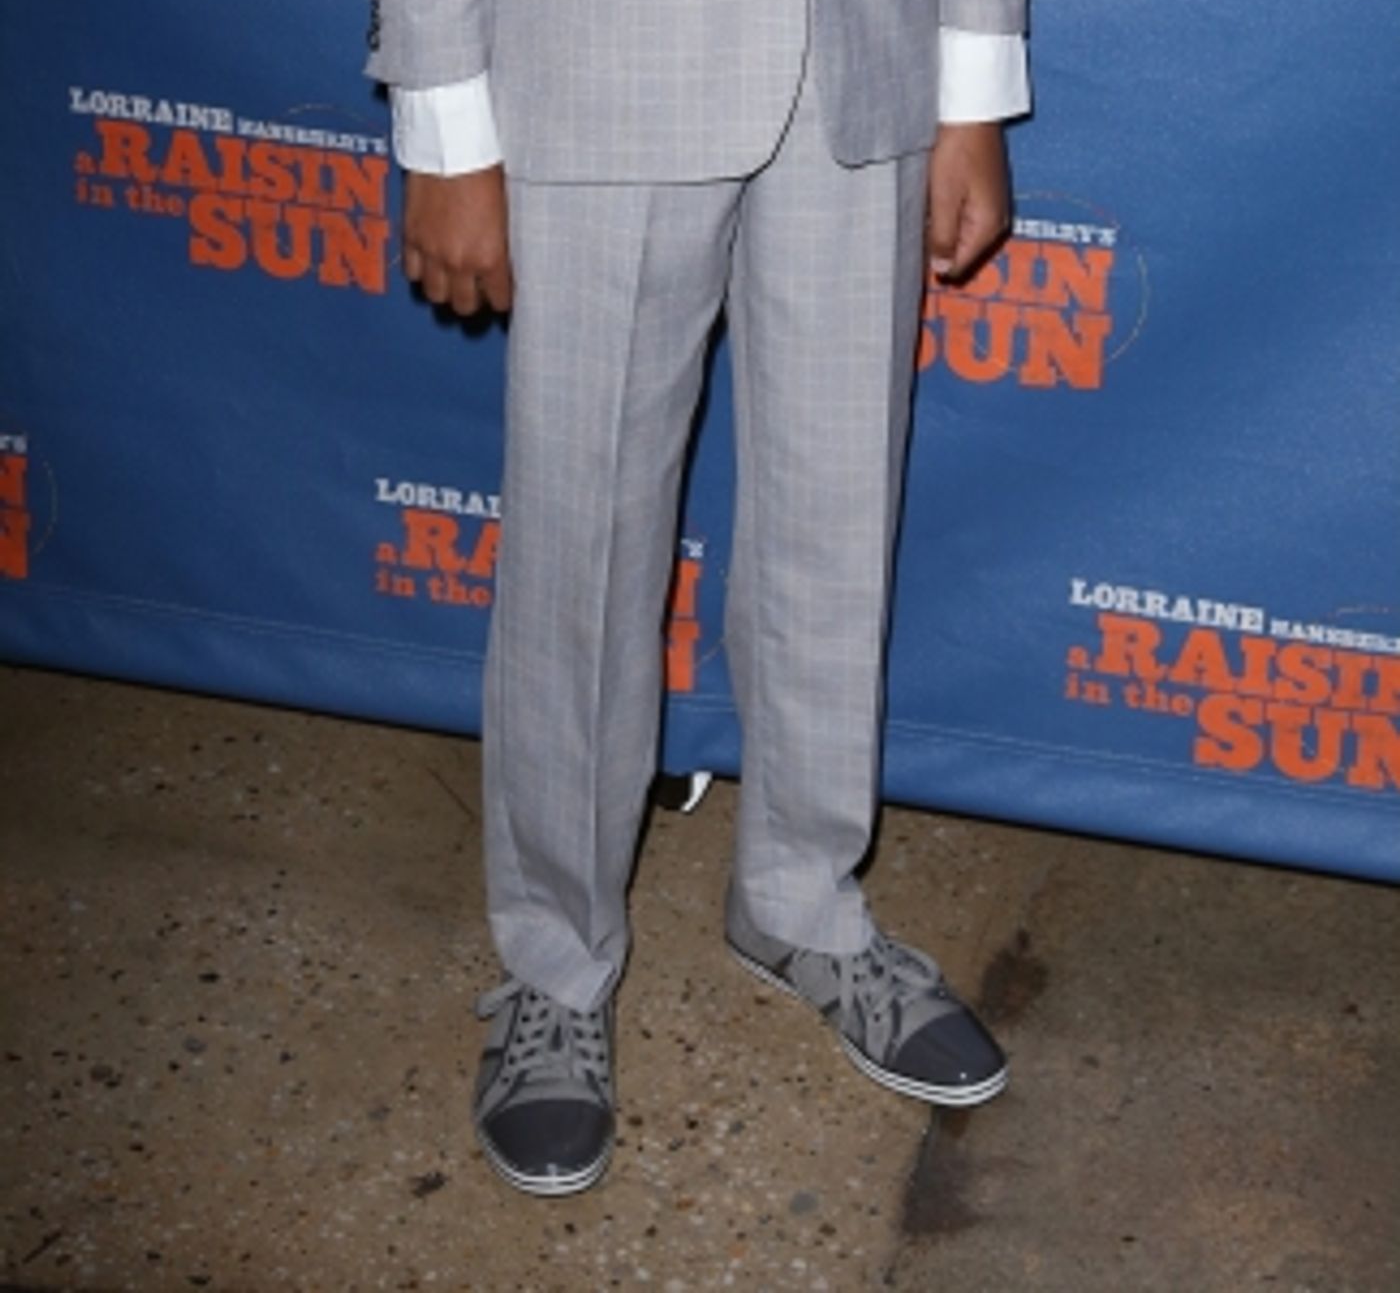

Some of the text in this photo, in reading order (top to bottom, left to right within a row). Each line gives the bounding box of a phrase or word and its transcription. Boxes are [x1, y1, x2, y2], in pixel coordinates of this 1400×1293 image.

[69, 87, 233, 132] LORRAINE
[74, 118, 389, 216] a RAISIN
[75, 179, 390, 295] in the SUN
[374, 541, 398, 563] a
[375, 569, 493, 606] in the
[1069, 578, 1265, 634] LORRAINE
[1066, 645, 1090, 669] a
[1065, 672, 1110, 705] in
[1123, 680, 1193, 716] the
